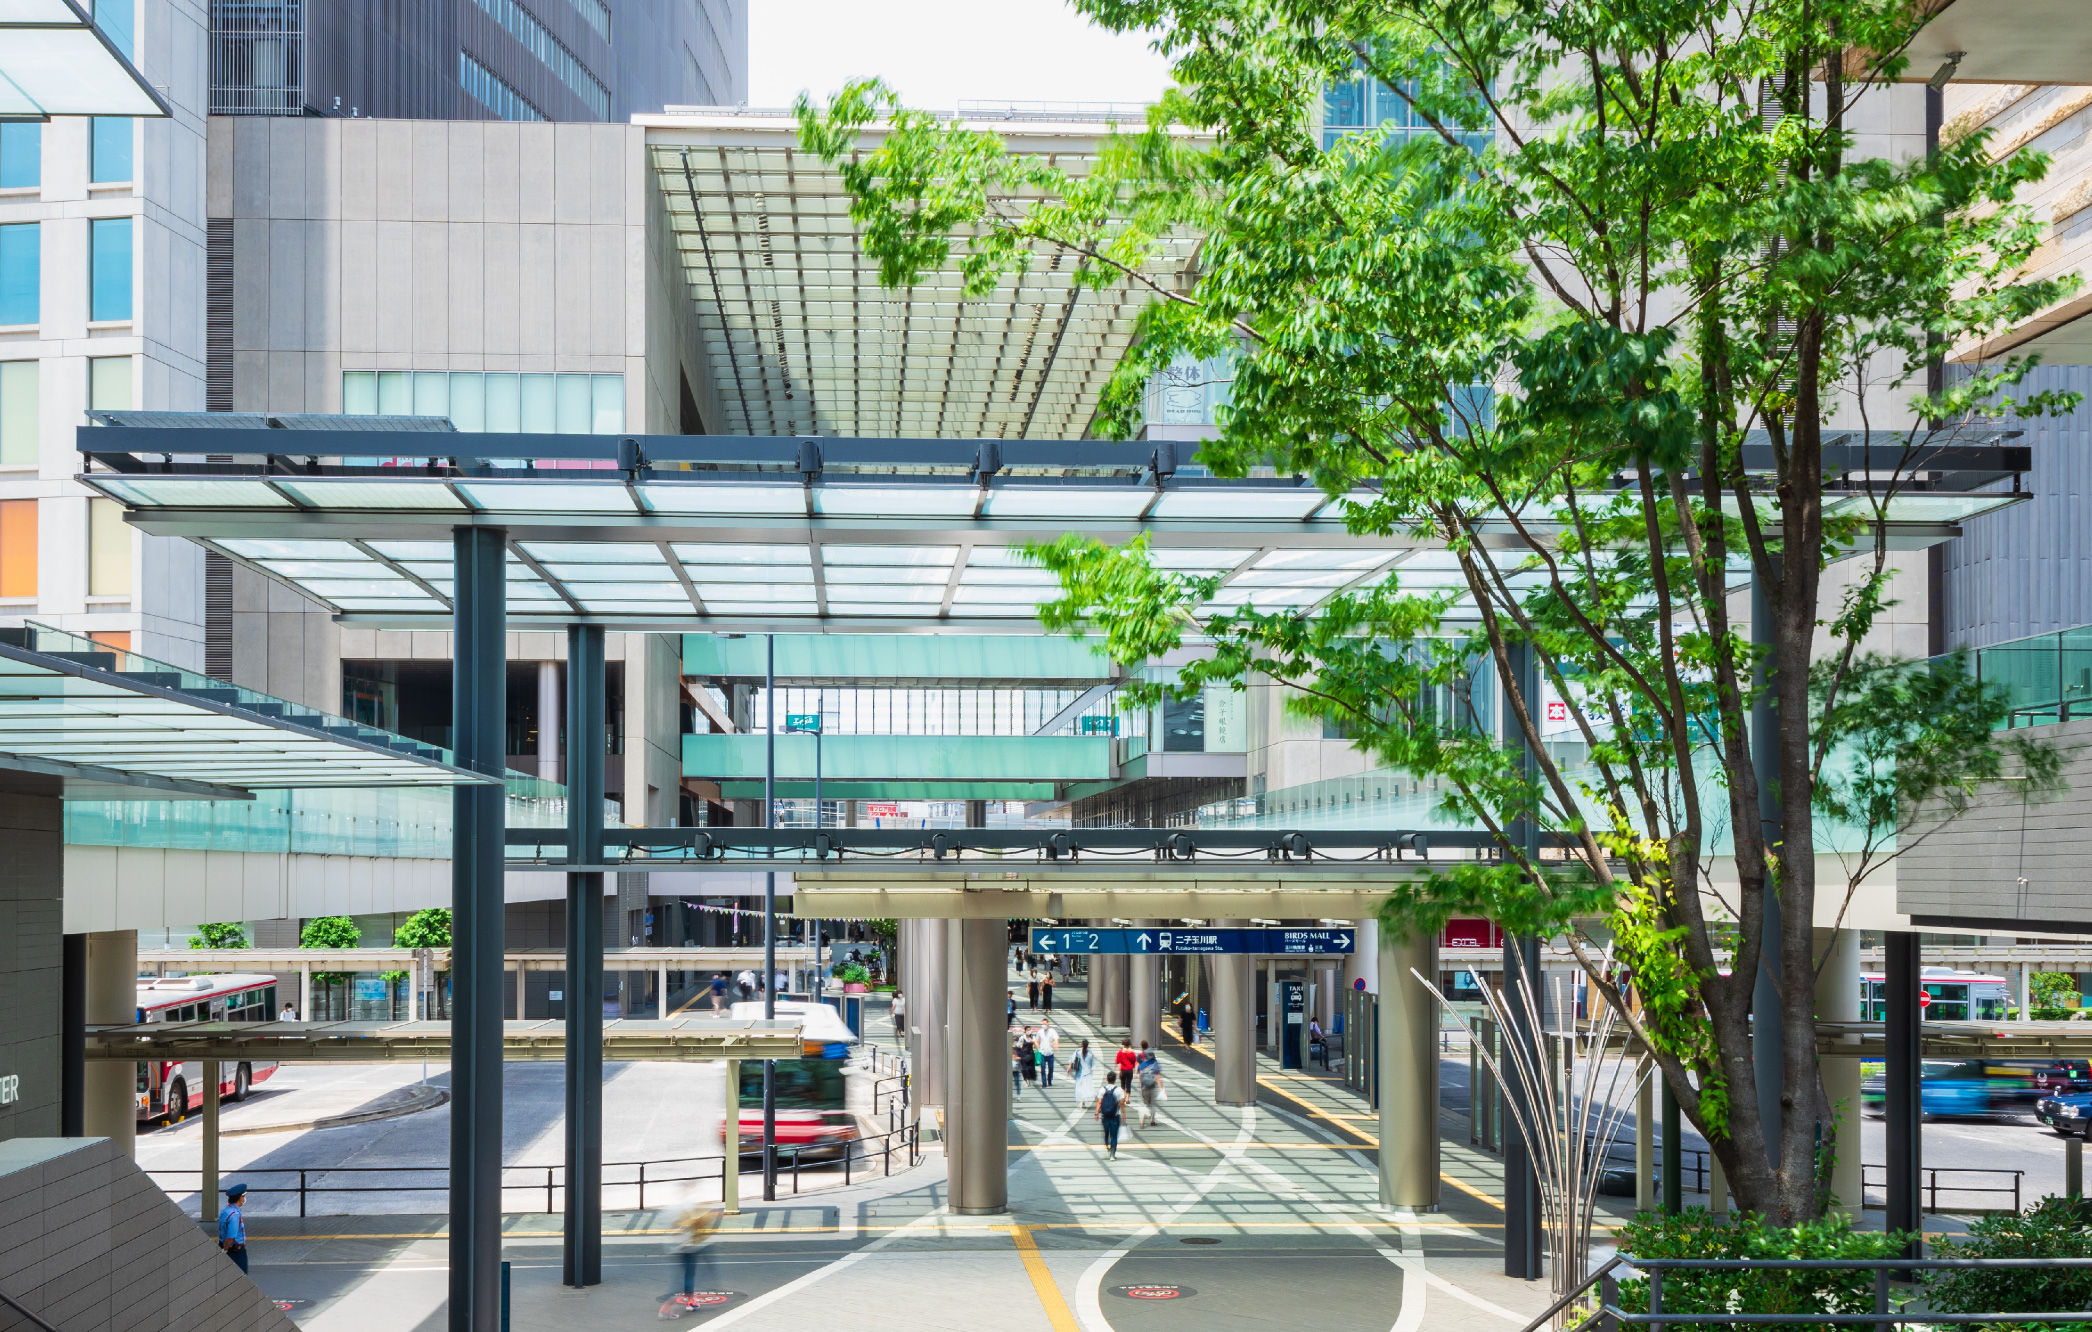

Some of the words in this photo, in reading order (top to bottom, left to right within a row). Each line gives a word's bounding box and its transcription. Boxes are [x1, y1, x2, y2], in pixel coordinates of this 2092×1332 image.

[1167, 367, 1200, 380] 整体
[1218, 699, 1227, 744] 金子眼鏡店
[1175, 935, 1217, 945] 二子玉川駅
